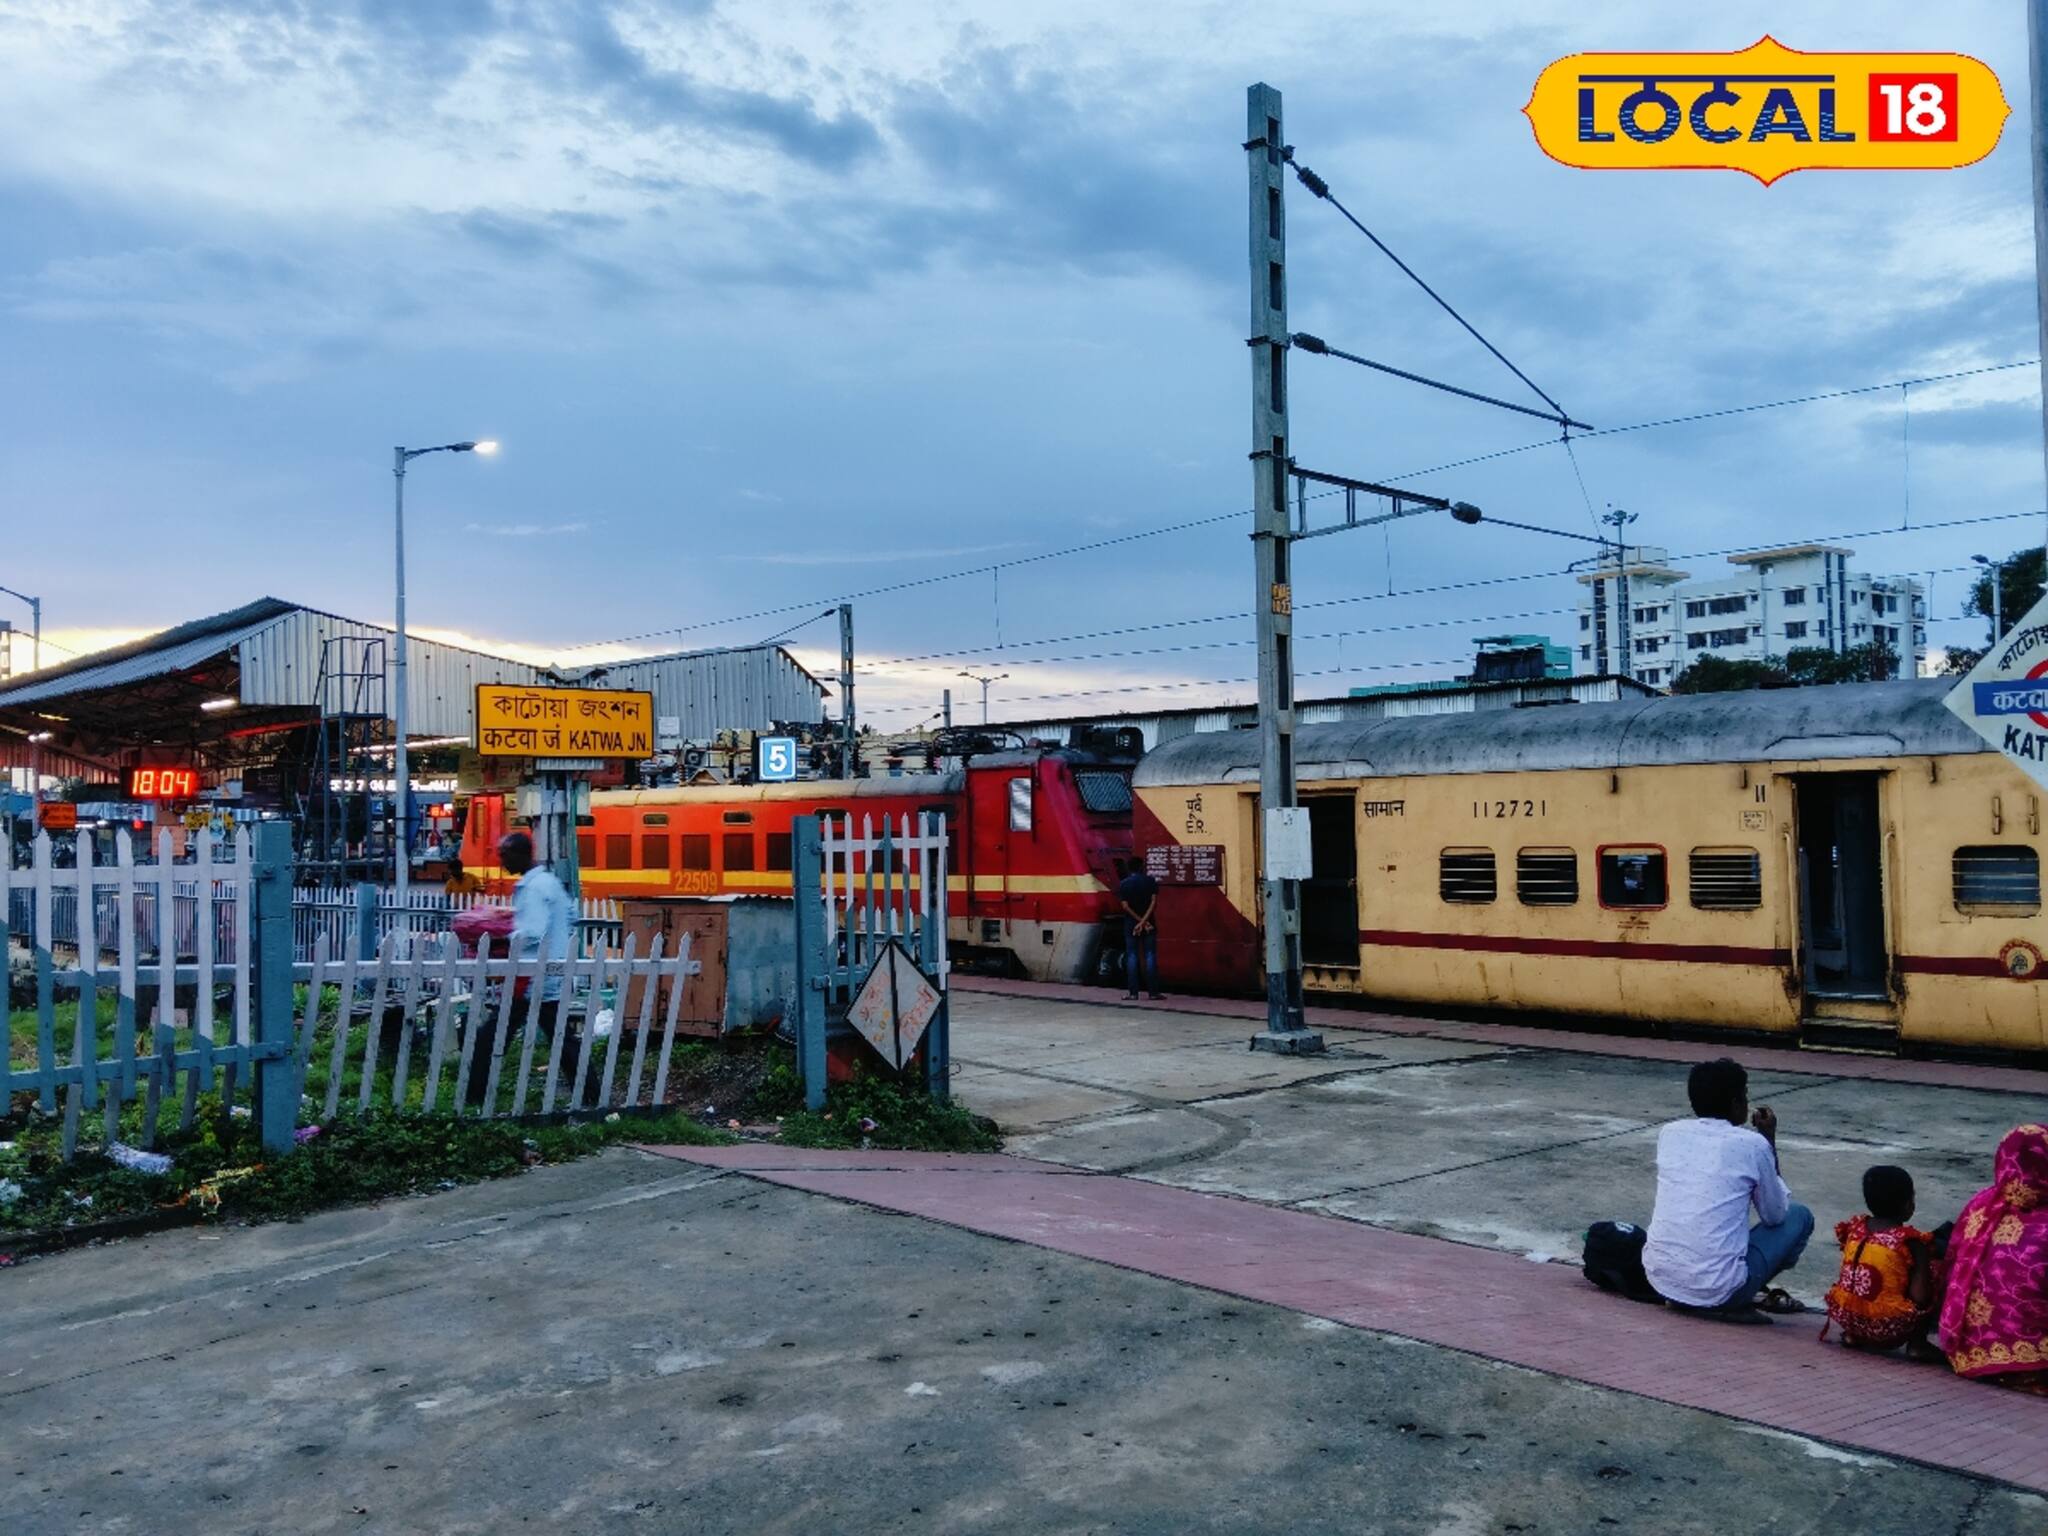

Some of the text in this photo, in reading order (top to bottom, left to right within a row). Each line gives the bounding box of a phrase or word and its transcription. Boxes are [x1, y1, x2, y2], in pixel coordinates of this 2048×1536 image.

[491, 690, 641, 721] কাটোয়া জংশন
[482, 723, 650, 752] कटवा जं KATWA JN.
[769, 745, 788, 772] 5
[132, 770, 191, 796] 18:04
[1363, 799, 1405, 818] सामान
[1473, 799, 1547, 818] 112721
[674, 870, 718, 893] 22509
